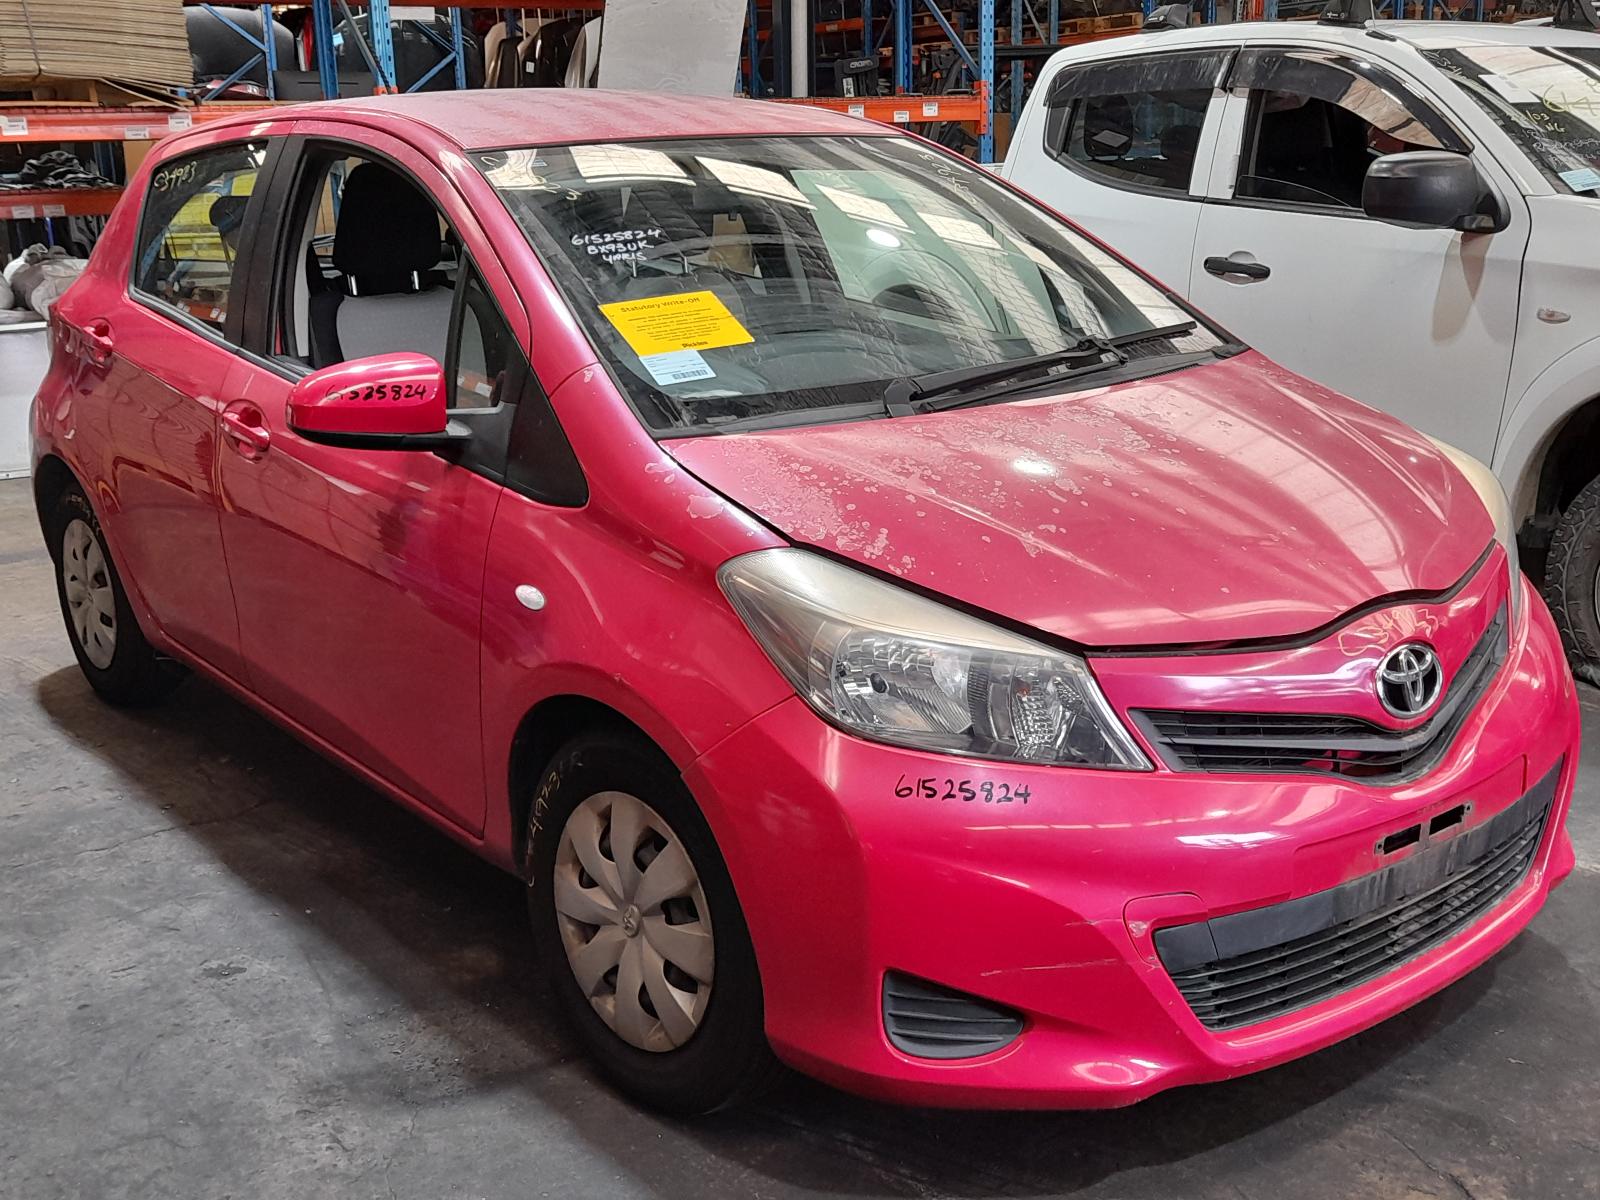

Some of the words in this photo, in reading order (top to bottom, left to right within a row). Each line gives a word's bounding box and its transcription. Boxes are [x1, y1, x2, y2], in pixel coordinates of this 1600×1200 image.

[571, 228, 661, 246] 61525824
[620, 303, 661, 313] Statutory
[894, 773, 1032, 804] 61525824
